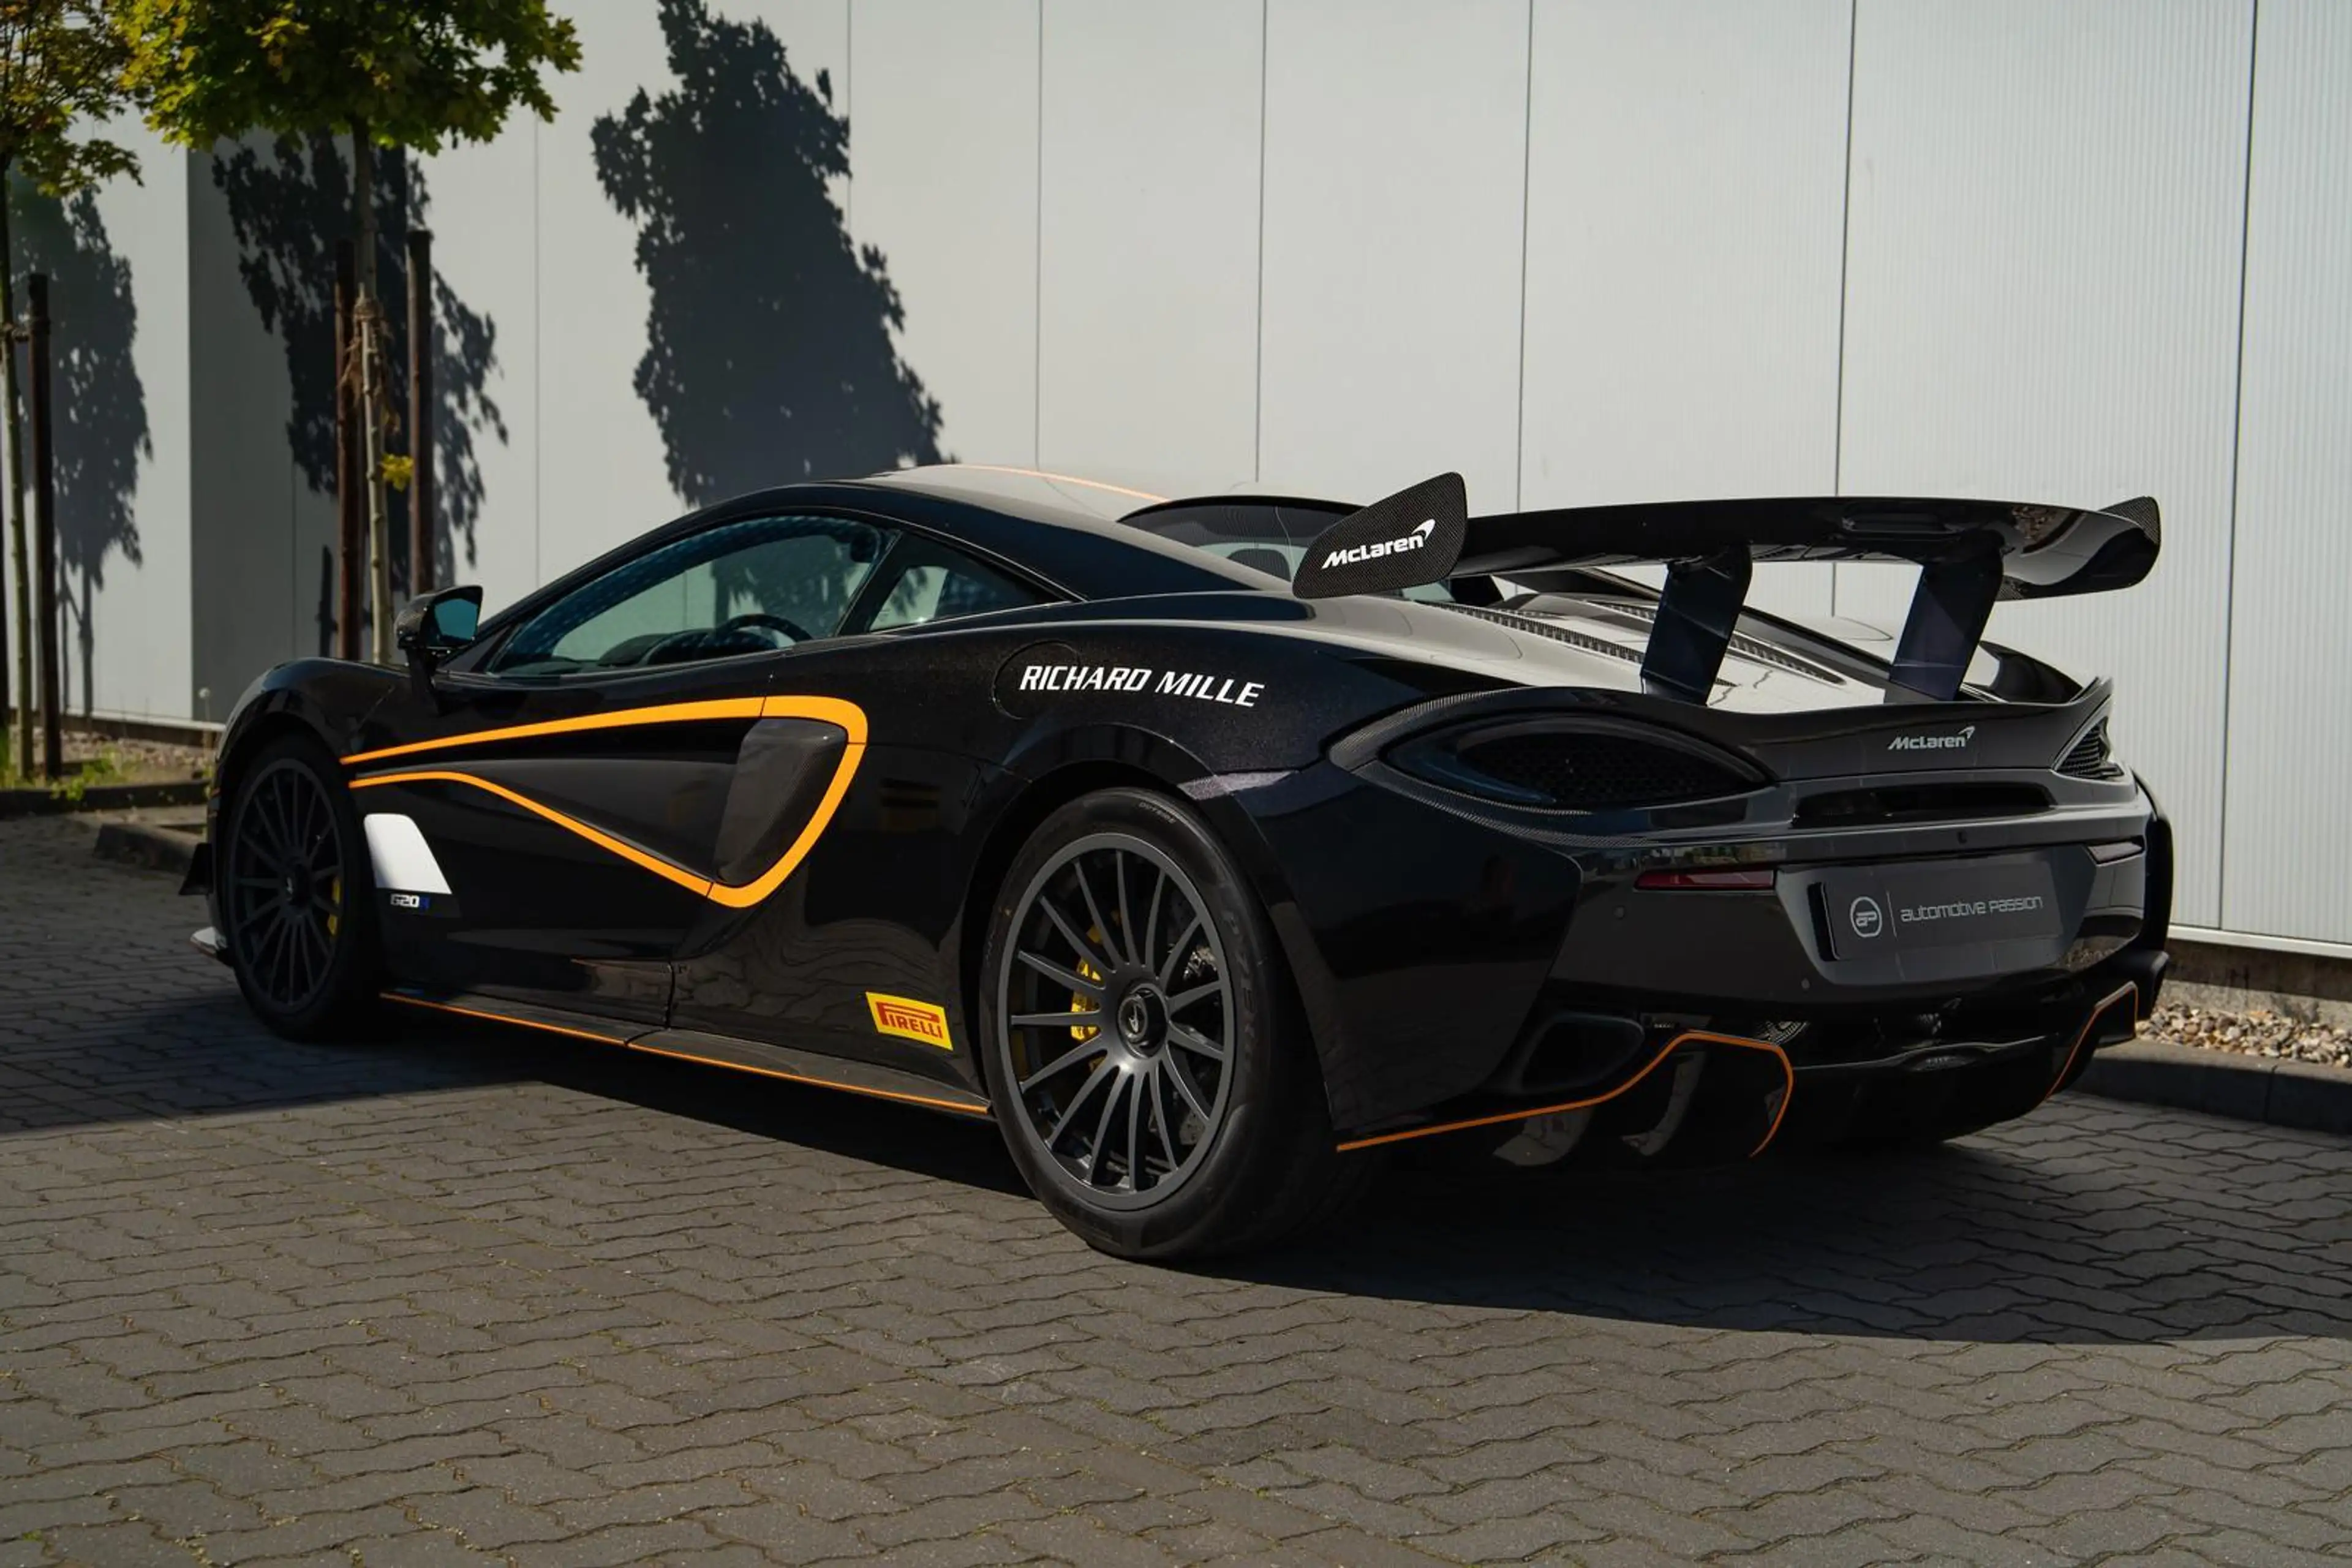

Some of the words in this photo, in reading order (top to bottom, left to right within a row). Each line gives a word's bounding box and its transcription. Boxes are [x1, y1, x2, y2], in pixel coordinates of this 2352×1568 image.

[1321, 533, 1425, 570] McLaren
[1019, 665, 1152, 692] RICHARD
[1155, 671, 1265, 707] MILLE
[1888, 736, 1966, 750] McLaren
[1900, 902, 1986, 922] automotive
[875, 1001, 943, 1039] PIRELLI
